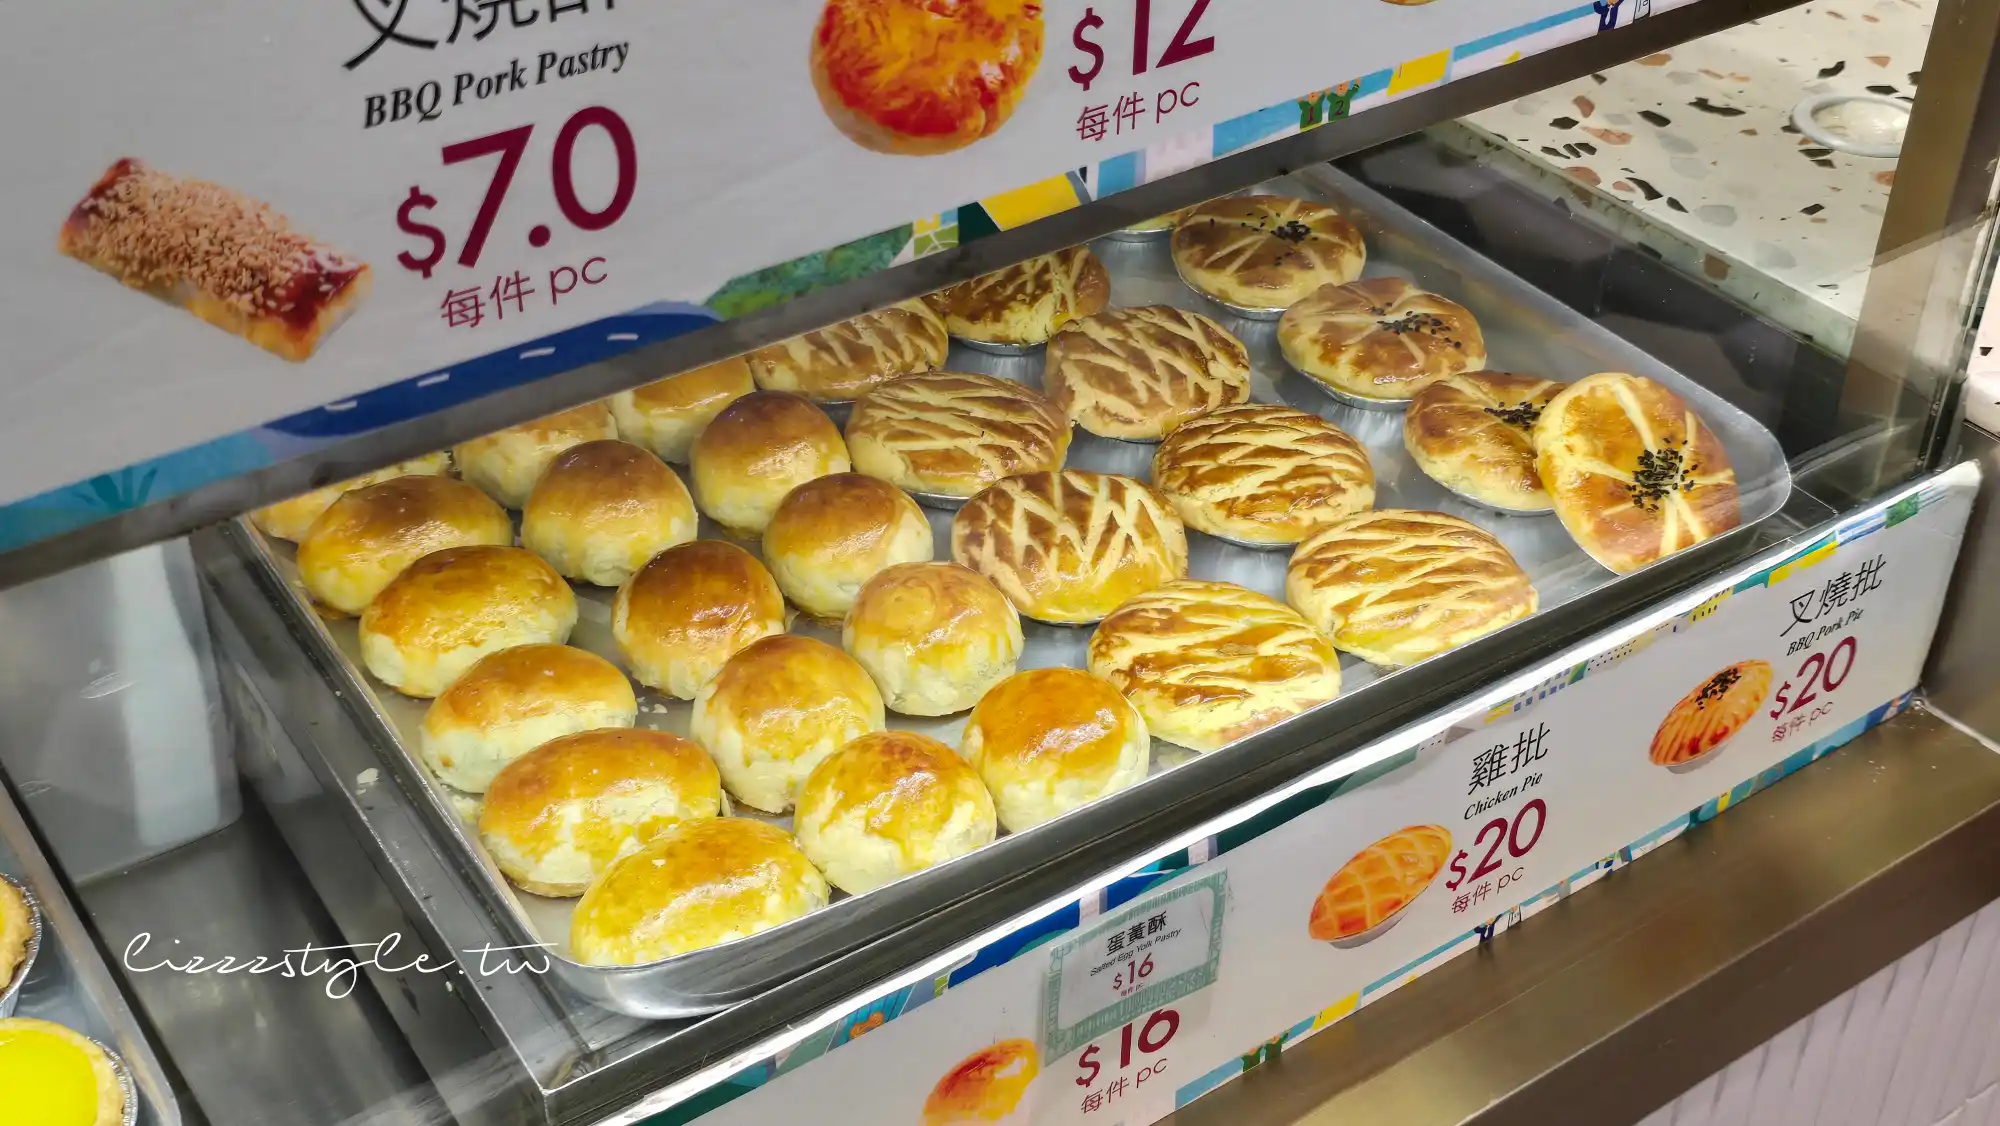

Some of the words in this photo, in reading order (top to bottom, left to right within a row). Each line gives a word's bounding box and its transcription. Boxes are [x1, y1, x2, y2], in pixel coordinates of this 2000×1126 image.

[363, 81, 443, 129] BBQ
[453, 58, 528, 106] Pork
[536, 42, 630, 86] Pastry
[1076, 92, 1146, 141] 每件
[1156, 81, 1200, 124] pc
[396, 106, 638, 279] $7.0
[441, 270, 535, 328] 每件
[550, 257, 608, 305] pc
[1779, 554, 1887, 637] 叉燒批
[1786, 631, 1816, 657] BBQ
[1844, 607, 1865, 626] Pie
[1769, 636, 1858, 721] $20
[1808, 701, 1834, 727] pc
[1467, 721, 1551, 796] 雞批
[1464, 782, 1519, 821] Chicken
[1521, 772, 1544, 793] Pie
[1445, 798, 1547, 892] $20
[1451, 880, 1492, 915] 每件
[1496, 867, 1525, 894] pc
[1112, 951, 1154, 990] $16
[1117, 949, 1135, 963] Egg
[1154, 928, 1182, 944] Pastry
[1080, 1076, 1130, 1114] 每件
[1136, 1058, 1168, 1088] pc
